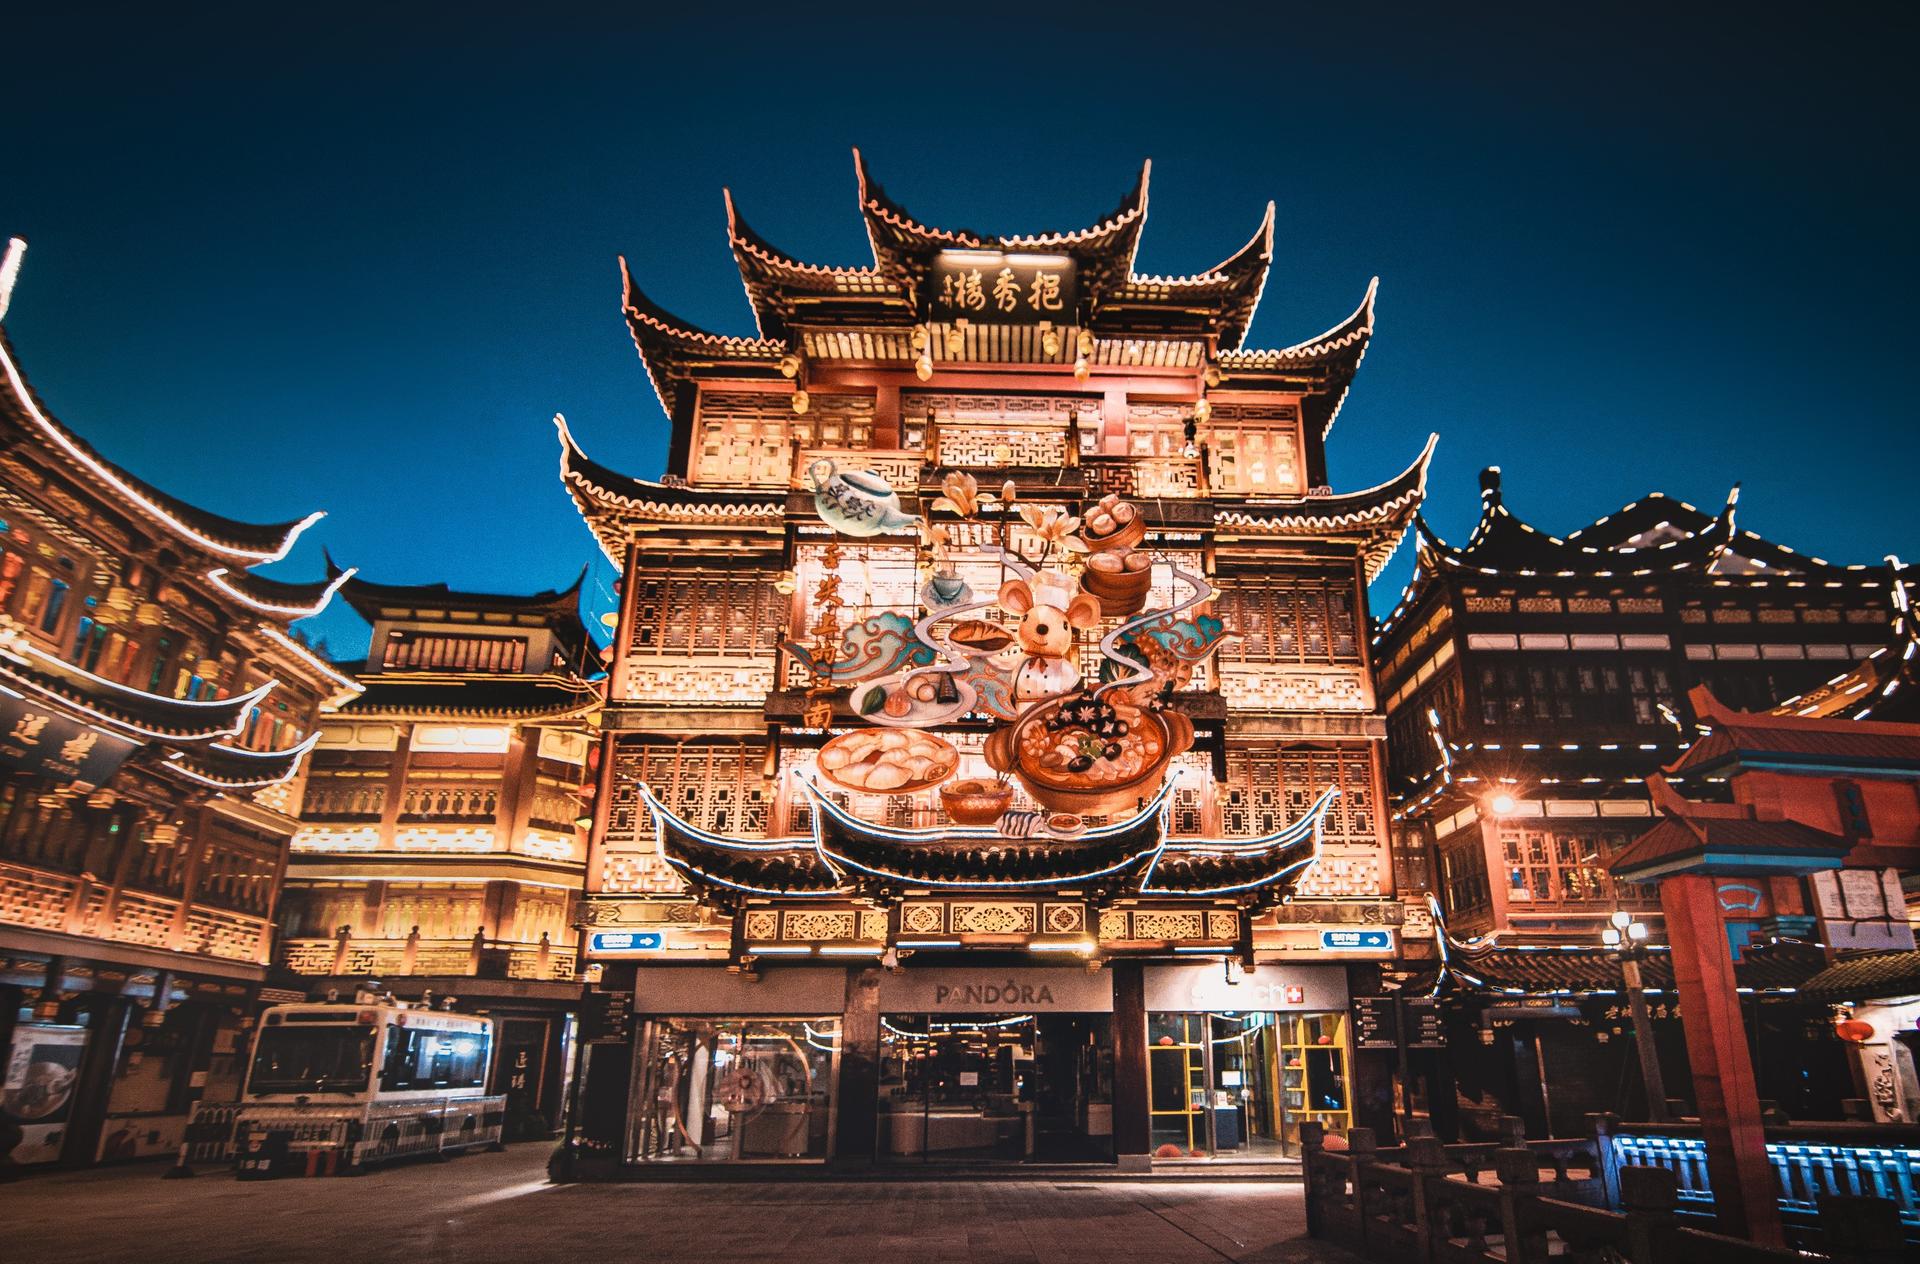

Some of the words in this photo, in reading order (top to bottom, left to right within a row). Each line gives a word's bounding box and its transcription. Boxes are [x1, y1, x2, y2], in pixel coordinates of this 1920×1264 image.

[803, 544, 845, 728] 舌尖上的江南
